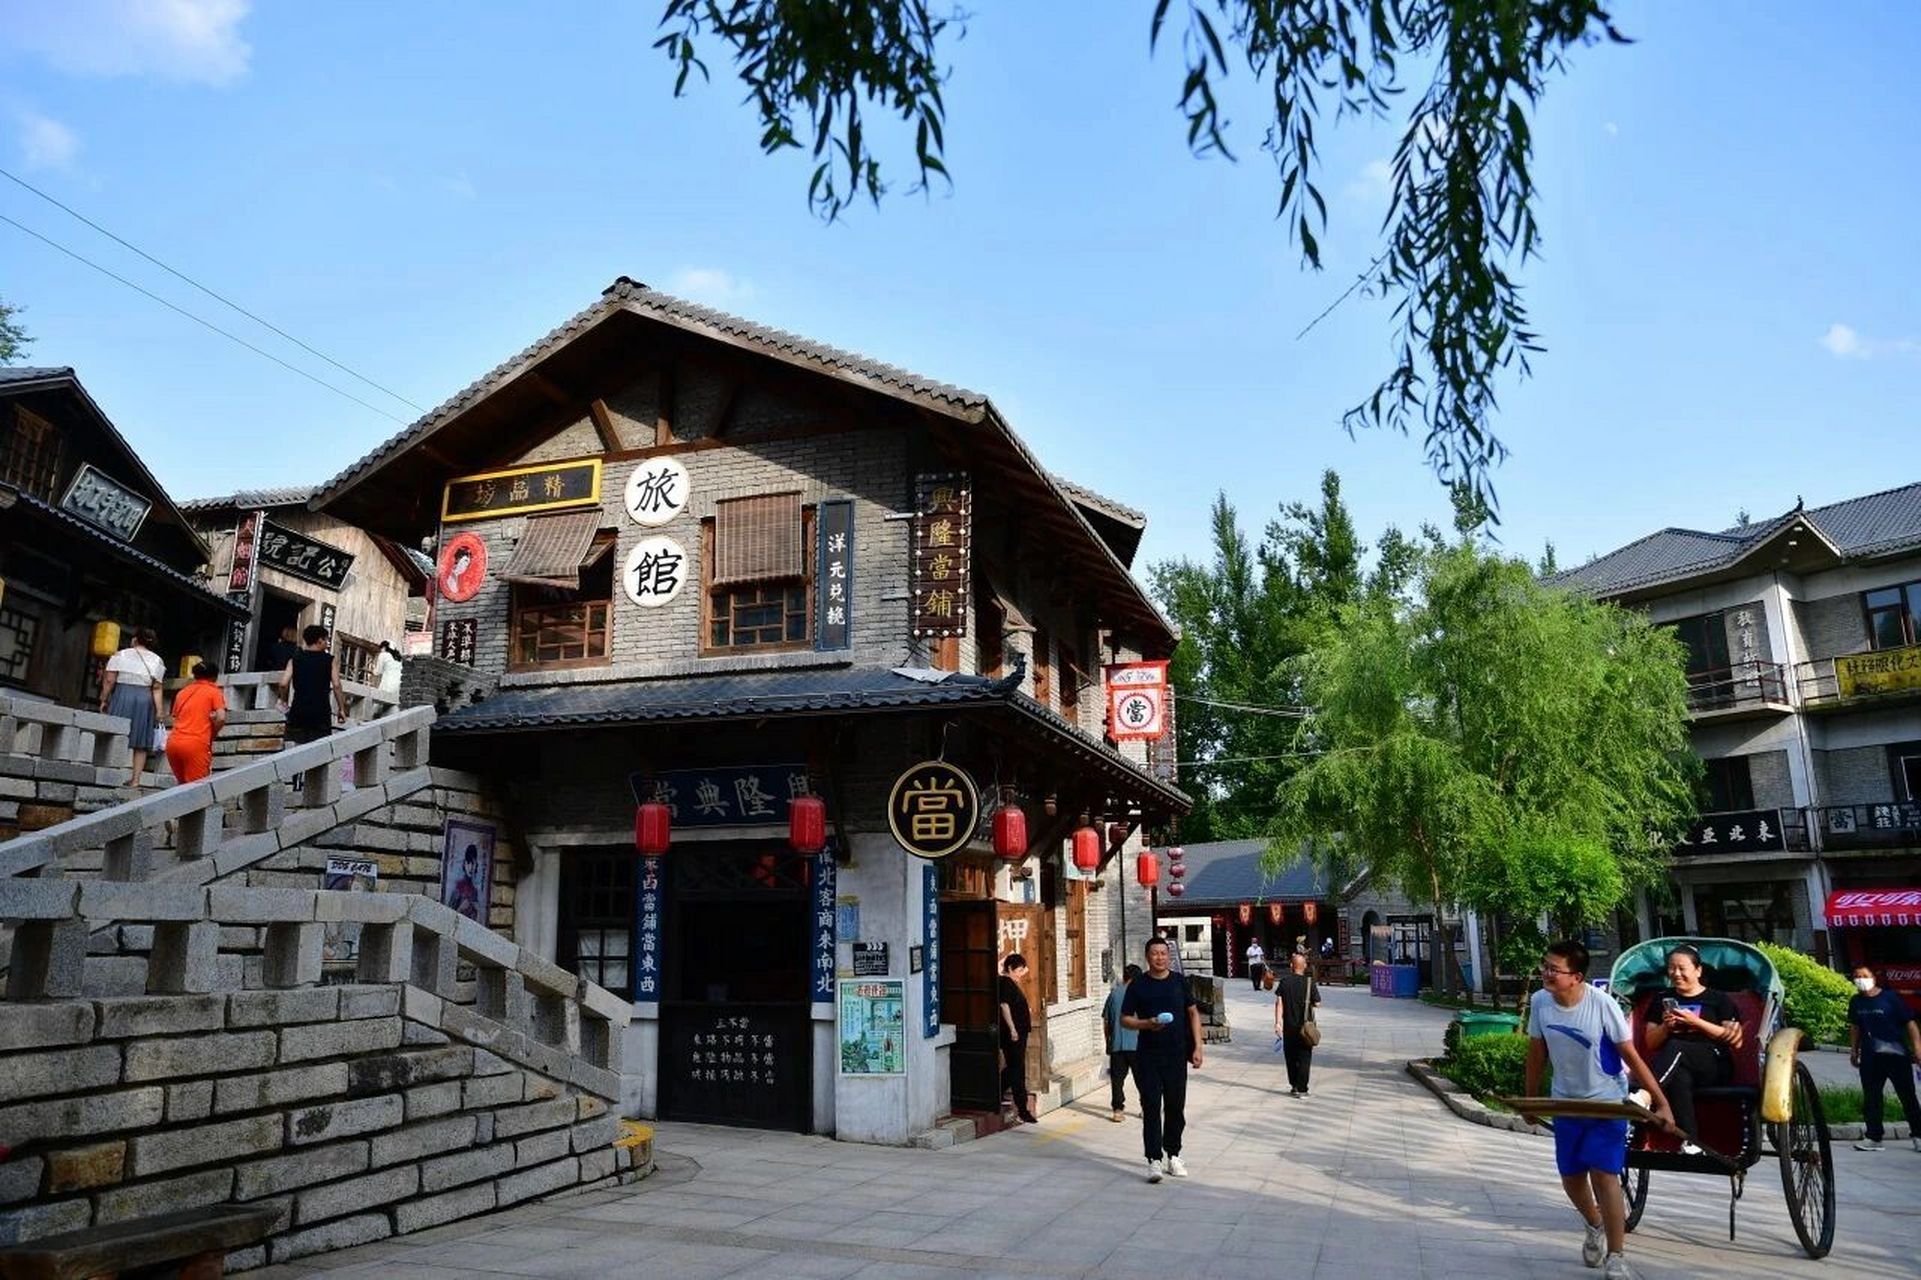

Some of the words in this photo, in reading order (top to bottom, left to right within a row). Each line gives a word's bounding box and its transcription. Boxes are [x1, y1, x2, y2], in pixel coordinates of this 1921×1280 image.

[634, 469, 679, 512] 旅
[632, 546, 684, 598] 館
[901, 776, 965, 851] 當
